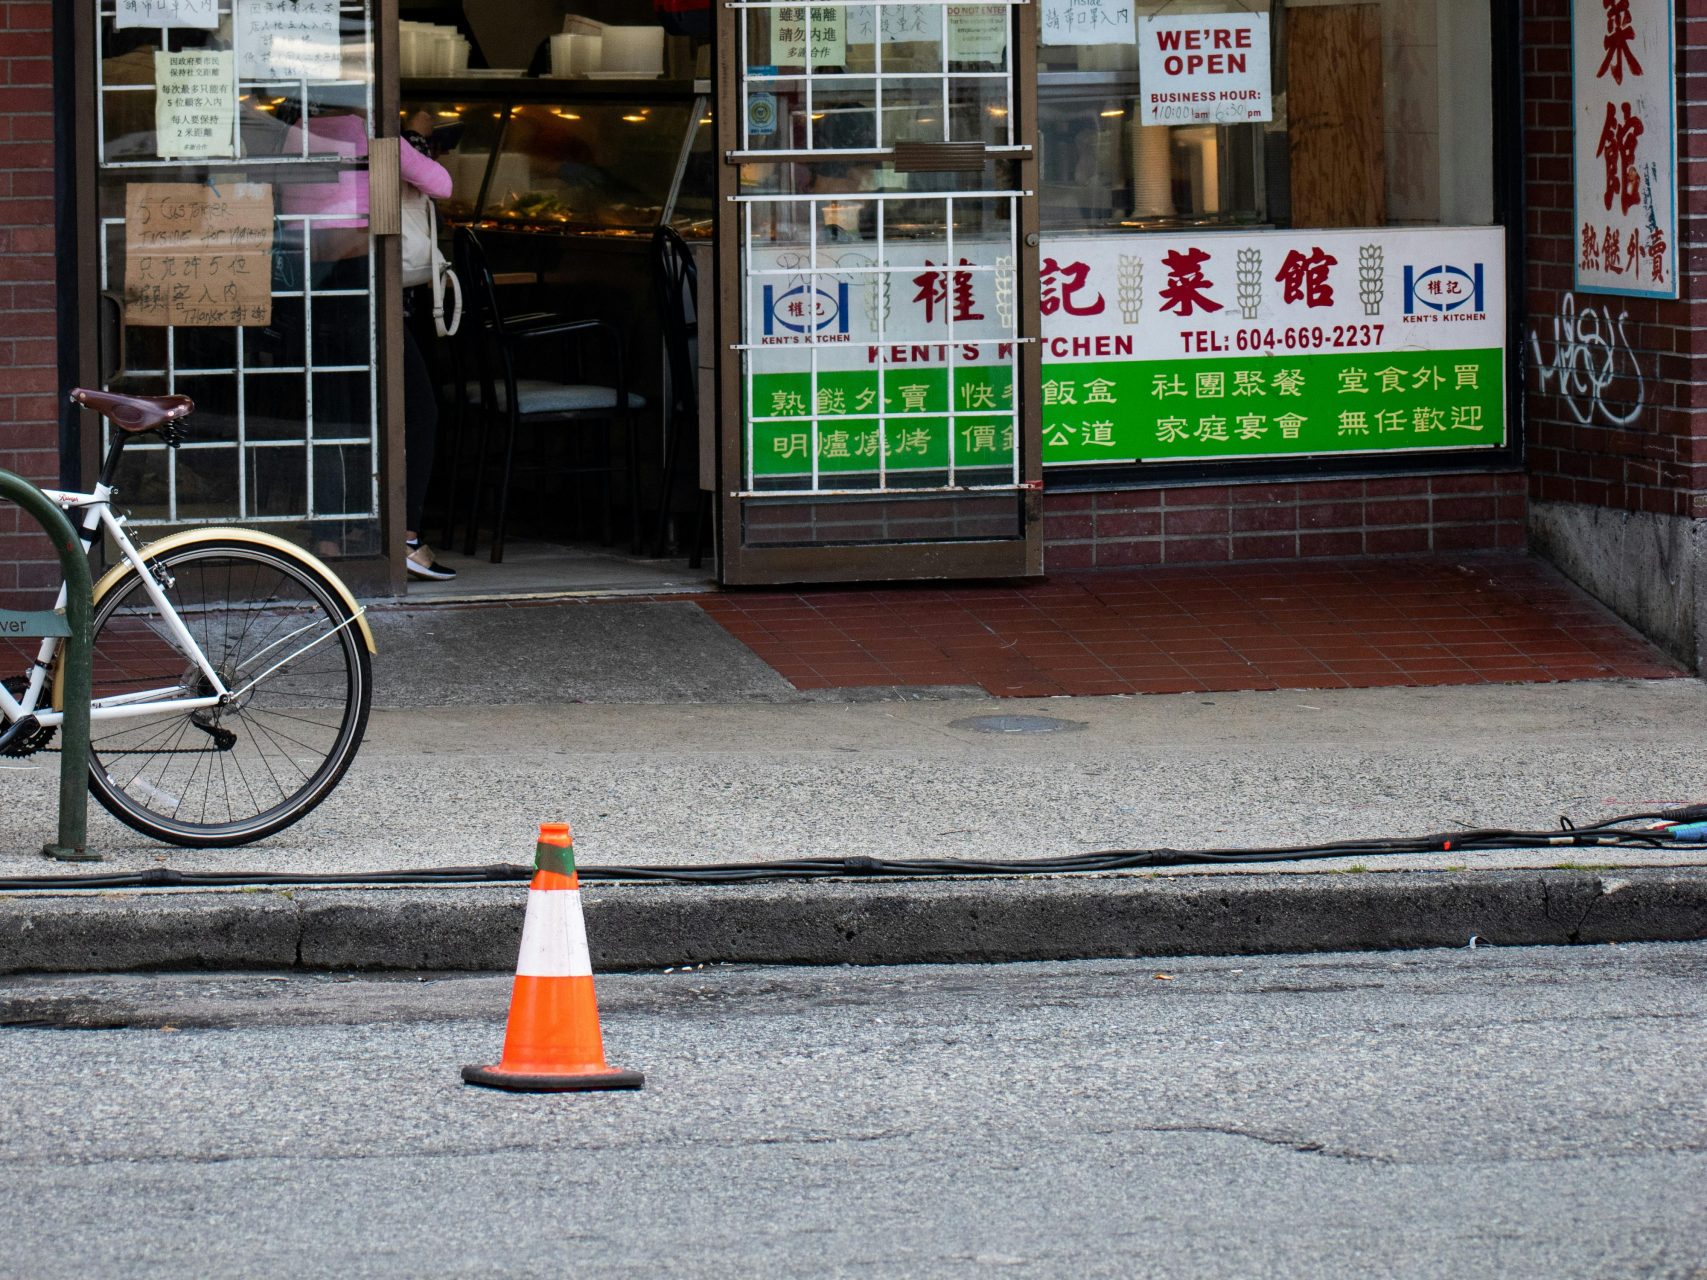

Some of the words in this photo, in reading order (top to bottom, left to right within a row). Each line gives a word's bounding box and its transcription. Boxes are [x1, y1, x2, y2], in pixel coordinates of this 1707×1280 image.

[1157, 28, 1252, 51] WE'RE
[1164, 53, 1246, 75] OPEN
[167, 99, 172, 107] 5
[1151, 91, 1216, 103] BUSINESS
[1219, 89, 1261, 101] HOUR:
[1247, 109, 1261, 118] pm
[177, 129, 182, 137] 2
[1427, 280, 1462, 295] 權記
[1403, 314, 1438, 323] KENT'S
[1443, 312, 1486, 322] KITCHEN
[762, 335, 799, 345] KENT'S
[805, 333, 850, 343] KTCHEN
[1180, 330, 1230, 353] TEL:
[1236, 324, 1385, 351] 604-669-2237
[1150, 367, 1307, 401] 社團聚餐
[1154, 411, 1309, 444] 家庭宴會
